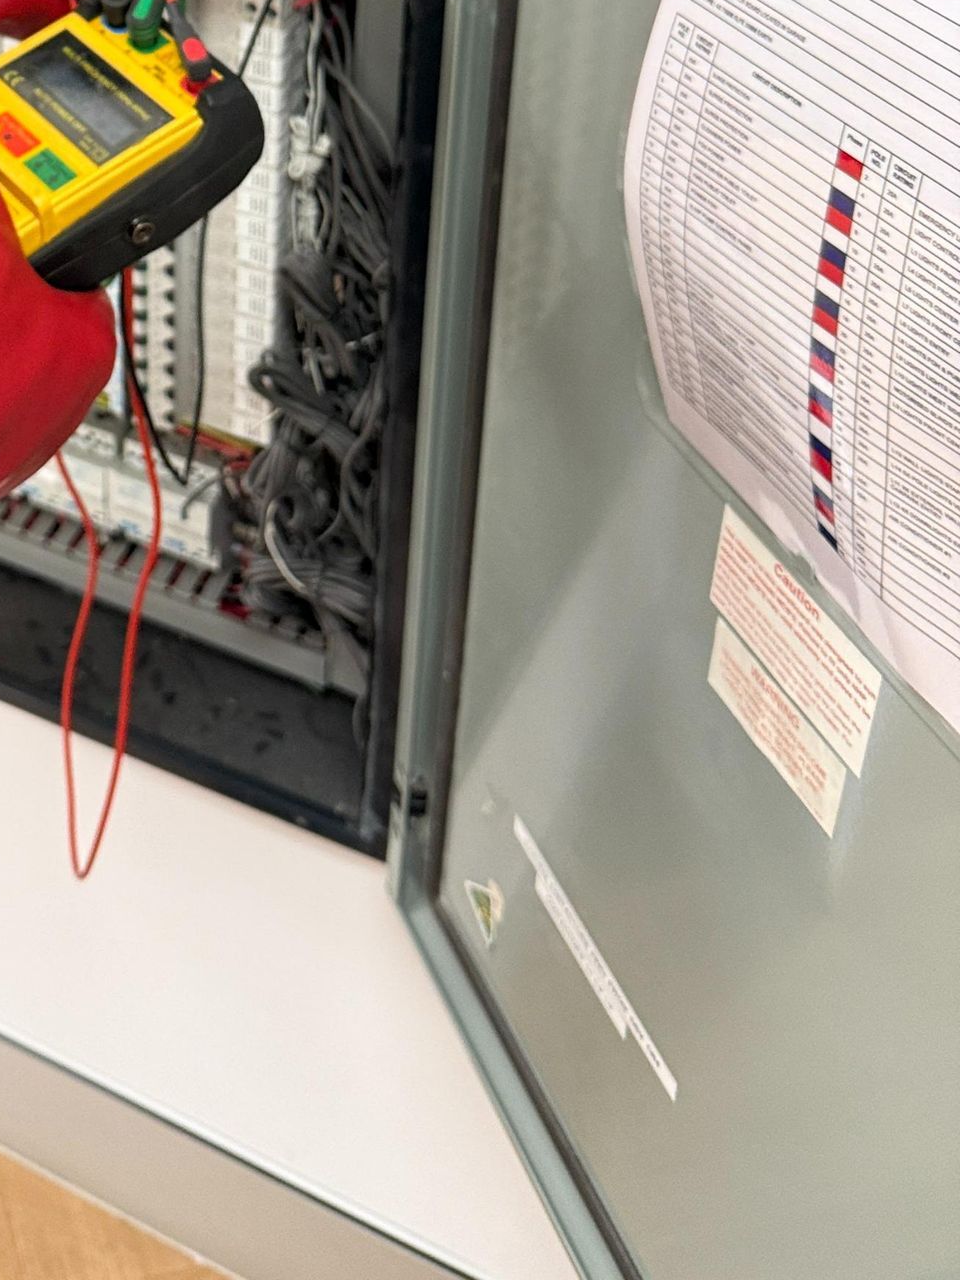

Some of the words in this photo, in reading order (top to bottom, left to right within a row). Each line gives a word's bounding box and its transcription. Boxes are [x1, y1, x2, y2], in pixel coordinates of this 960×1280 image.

[871, 148, 885, 162] POLE
[892, 172, 914, 189] RATING
[893, 163, 916, 181] CIRCUIT
[914, 228, 932, 243] LIGHT
[932, 240, 960, 264] CONTRO
[918, 253, 940, 271] LIGHTS
[915, 271, 937, 289] LIGHTS
[912, 290, 933, 308] LIGHTS
[909, 307, 931, 325] LIGHTS
[907, 325, 929, 343] LIGHTS
[772, 561, 822, 624] Caution
[747, 667, 802, 732] WARNING
